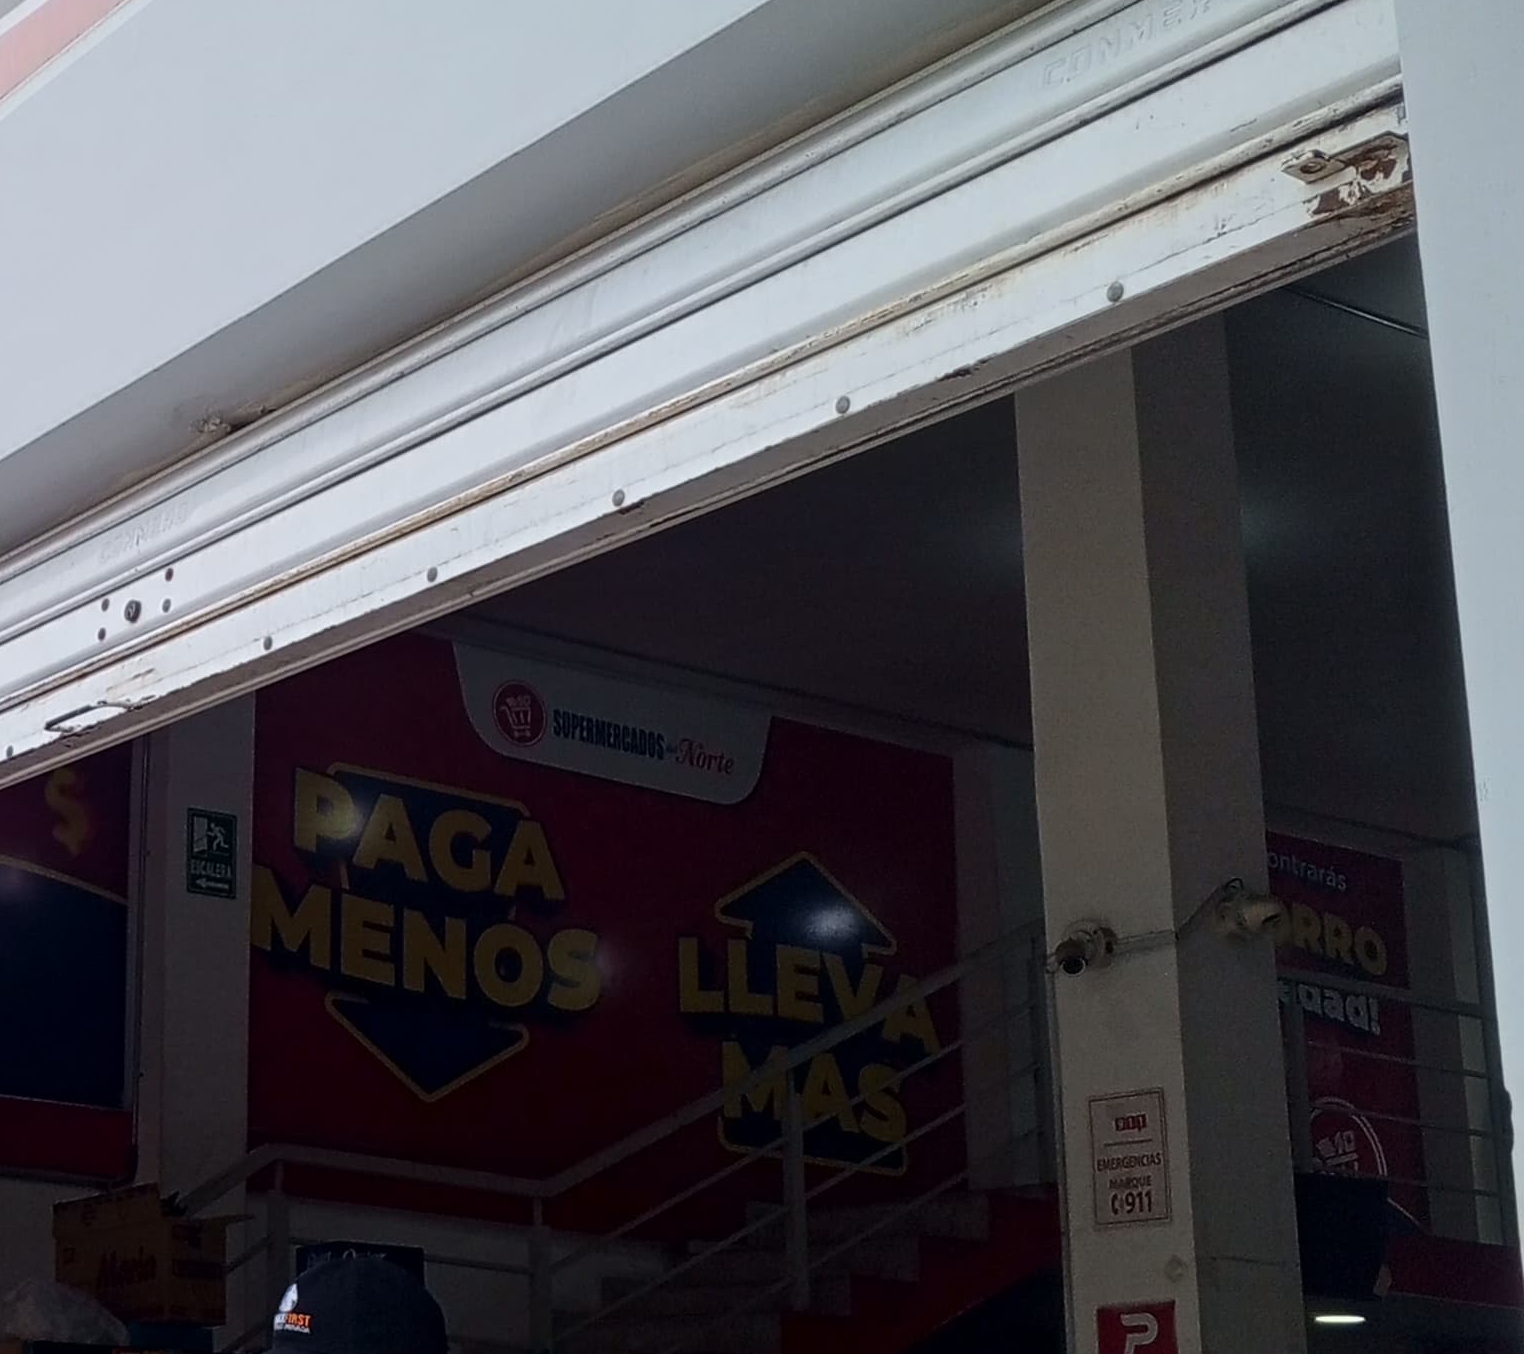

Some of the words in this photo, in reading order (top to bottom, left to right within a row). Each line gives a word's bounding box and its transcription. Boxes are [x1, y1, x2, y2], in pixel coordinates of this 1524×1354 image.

[552, 708, 666, 761] SUPERMERCADOS
[674, 737, 735, 776] Norte
[292, 766, 568, 901] PAGA
[189, 860, 233, 879] ESCALERA
[250, 863, 604, 1013] MENOS
[677, 934, 942, 1057] LLEVA
[1096, 1152, 1162, 1172] EMERGENCIAS
[1108, 1174, 1153, 1190] MARQUE
[1125, 1190, 1153, 1214] 911
